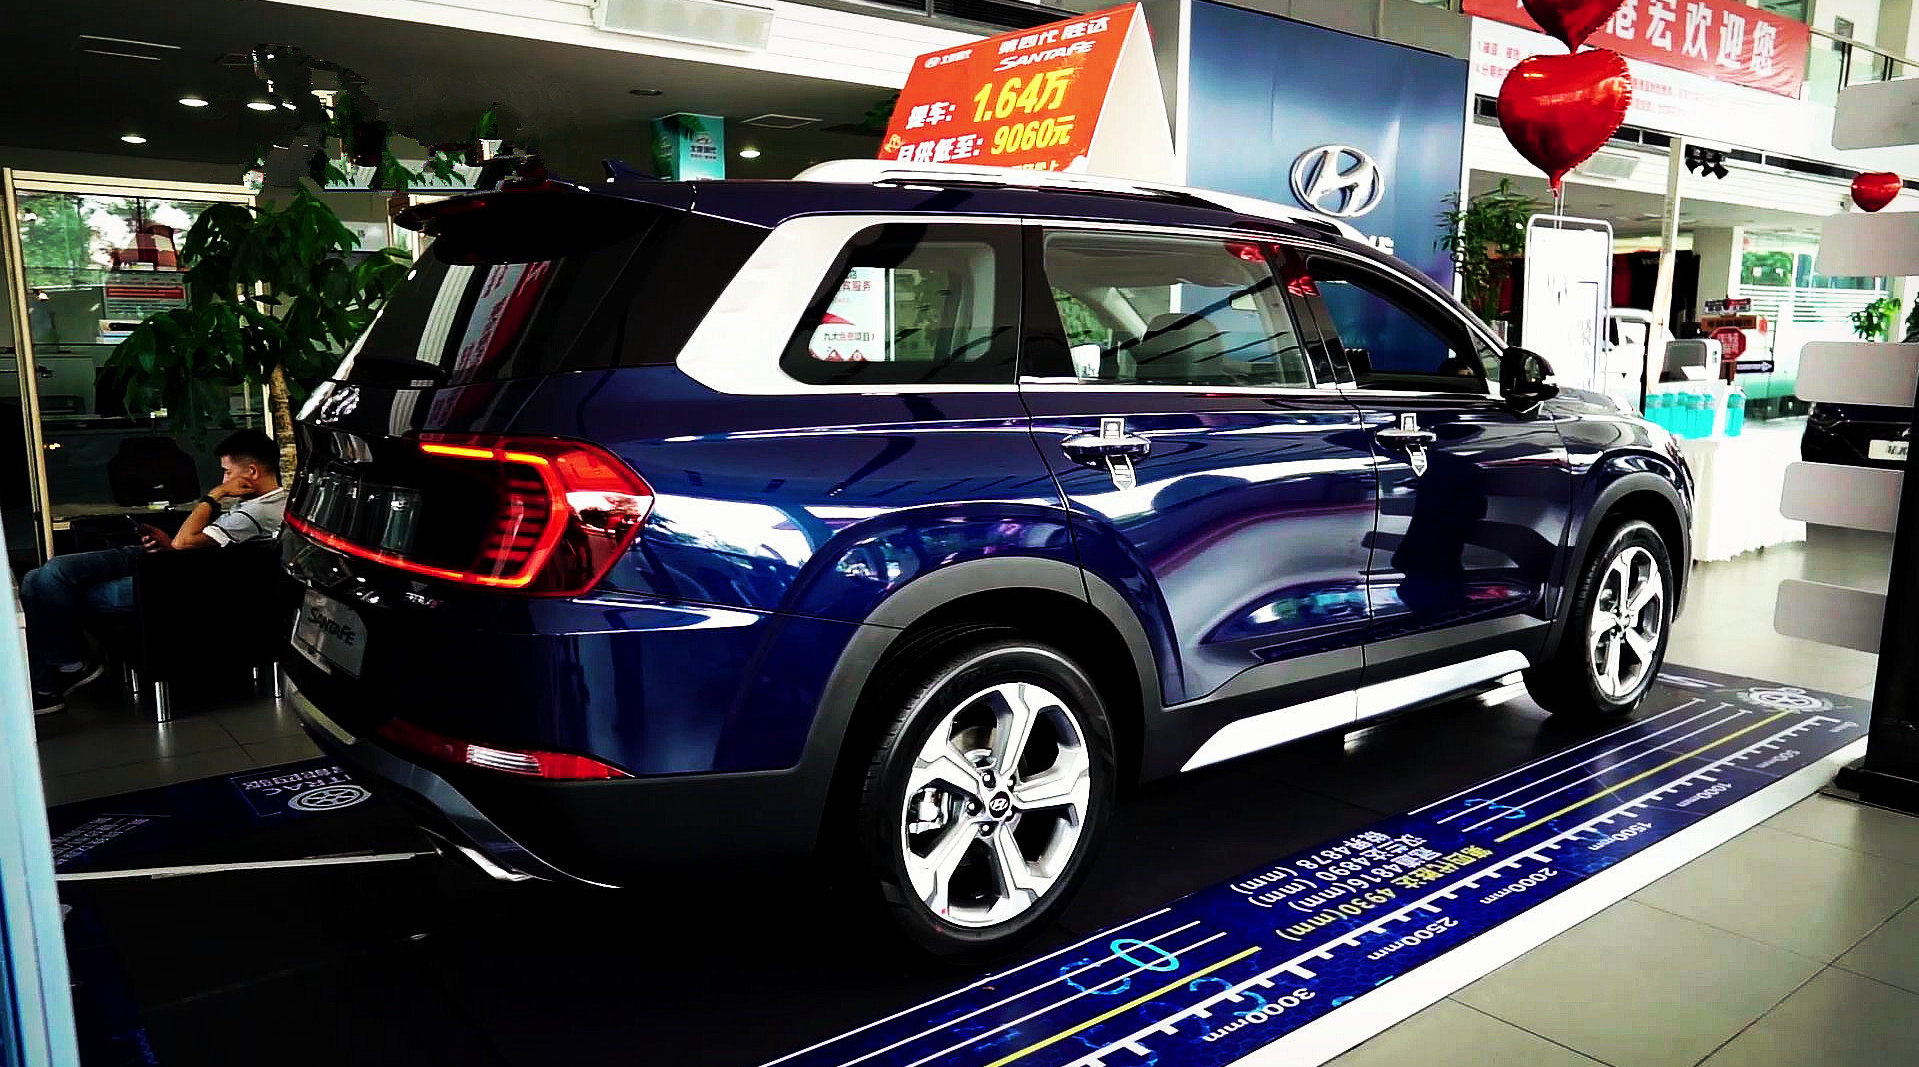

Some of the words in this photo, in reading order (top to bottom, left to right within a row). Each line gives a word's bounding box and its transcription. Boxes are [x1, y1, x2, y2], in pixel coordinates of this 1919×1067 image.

[973, 67, 1074, 122] 1.64万
[990, 115, 1075, 155] 9060元
[1676, 782, 1732, 808] 1000mm
[1587, 821, 1652, 851] 1500mm
[1479, 866, 1557, 905] 2000mm
[1367, 916, 1458, 960] 2500mm
[1202, 987, 1316, 1043] 3000mm
